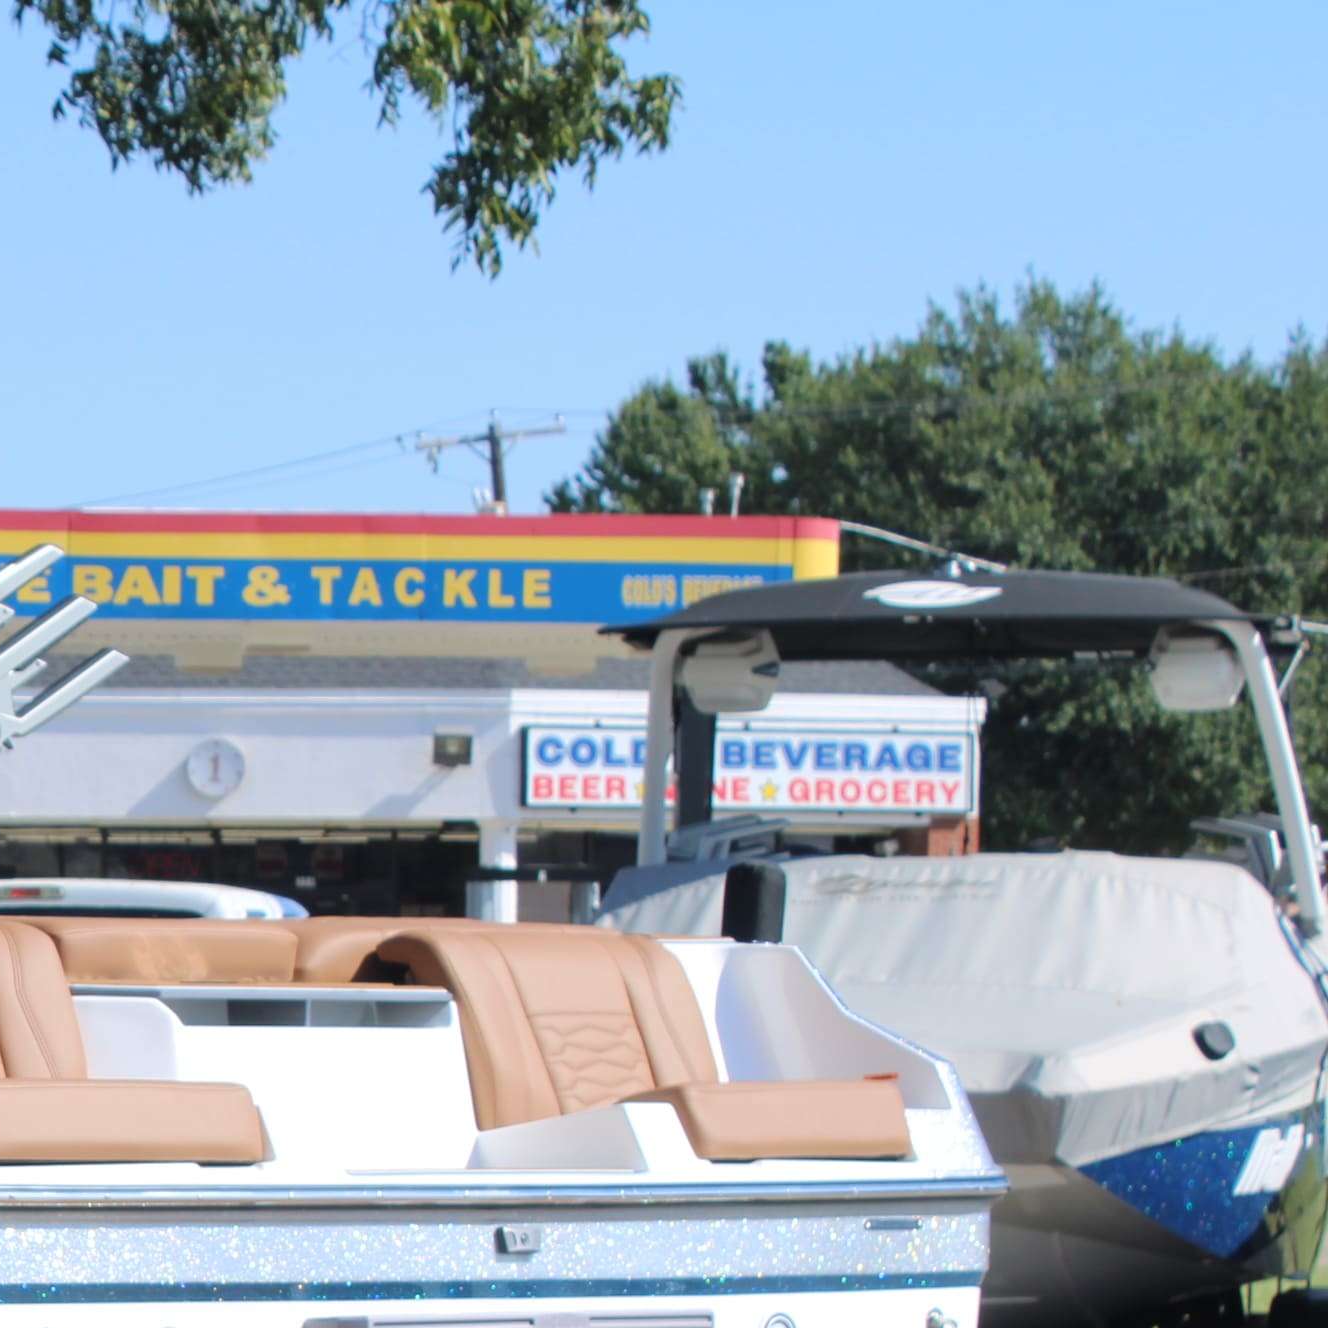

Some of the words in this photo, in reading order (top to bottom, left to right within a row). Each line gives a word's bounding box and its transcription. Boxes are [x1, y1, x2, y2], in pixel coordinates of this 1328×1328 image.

[73, 565, 224, 606] BAIT
[242, 565, 292, 607] &
[310, 565, 553, 609] TACKLE
[720, 740, 962, 773] BEVERAGE
[532, 773, 627, 801] BEER
[787, 779, 962, 806] GROCERY
